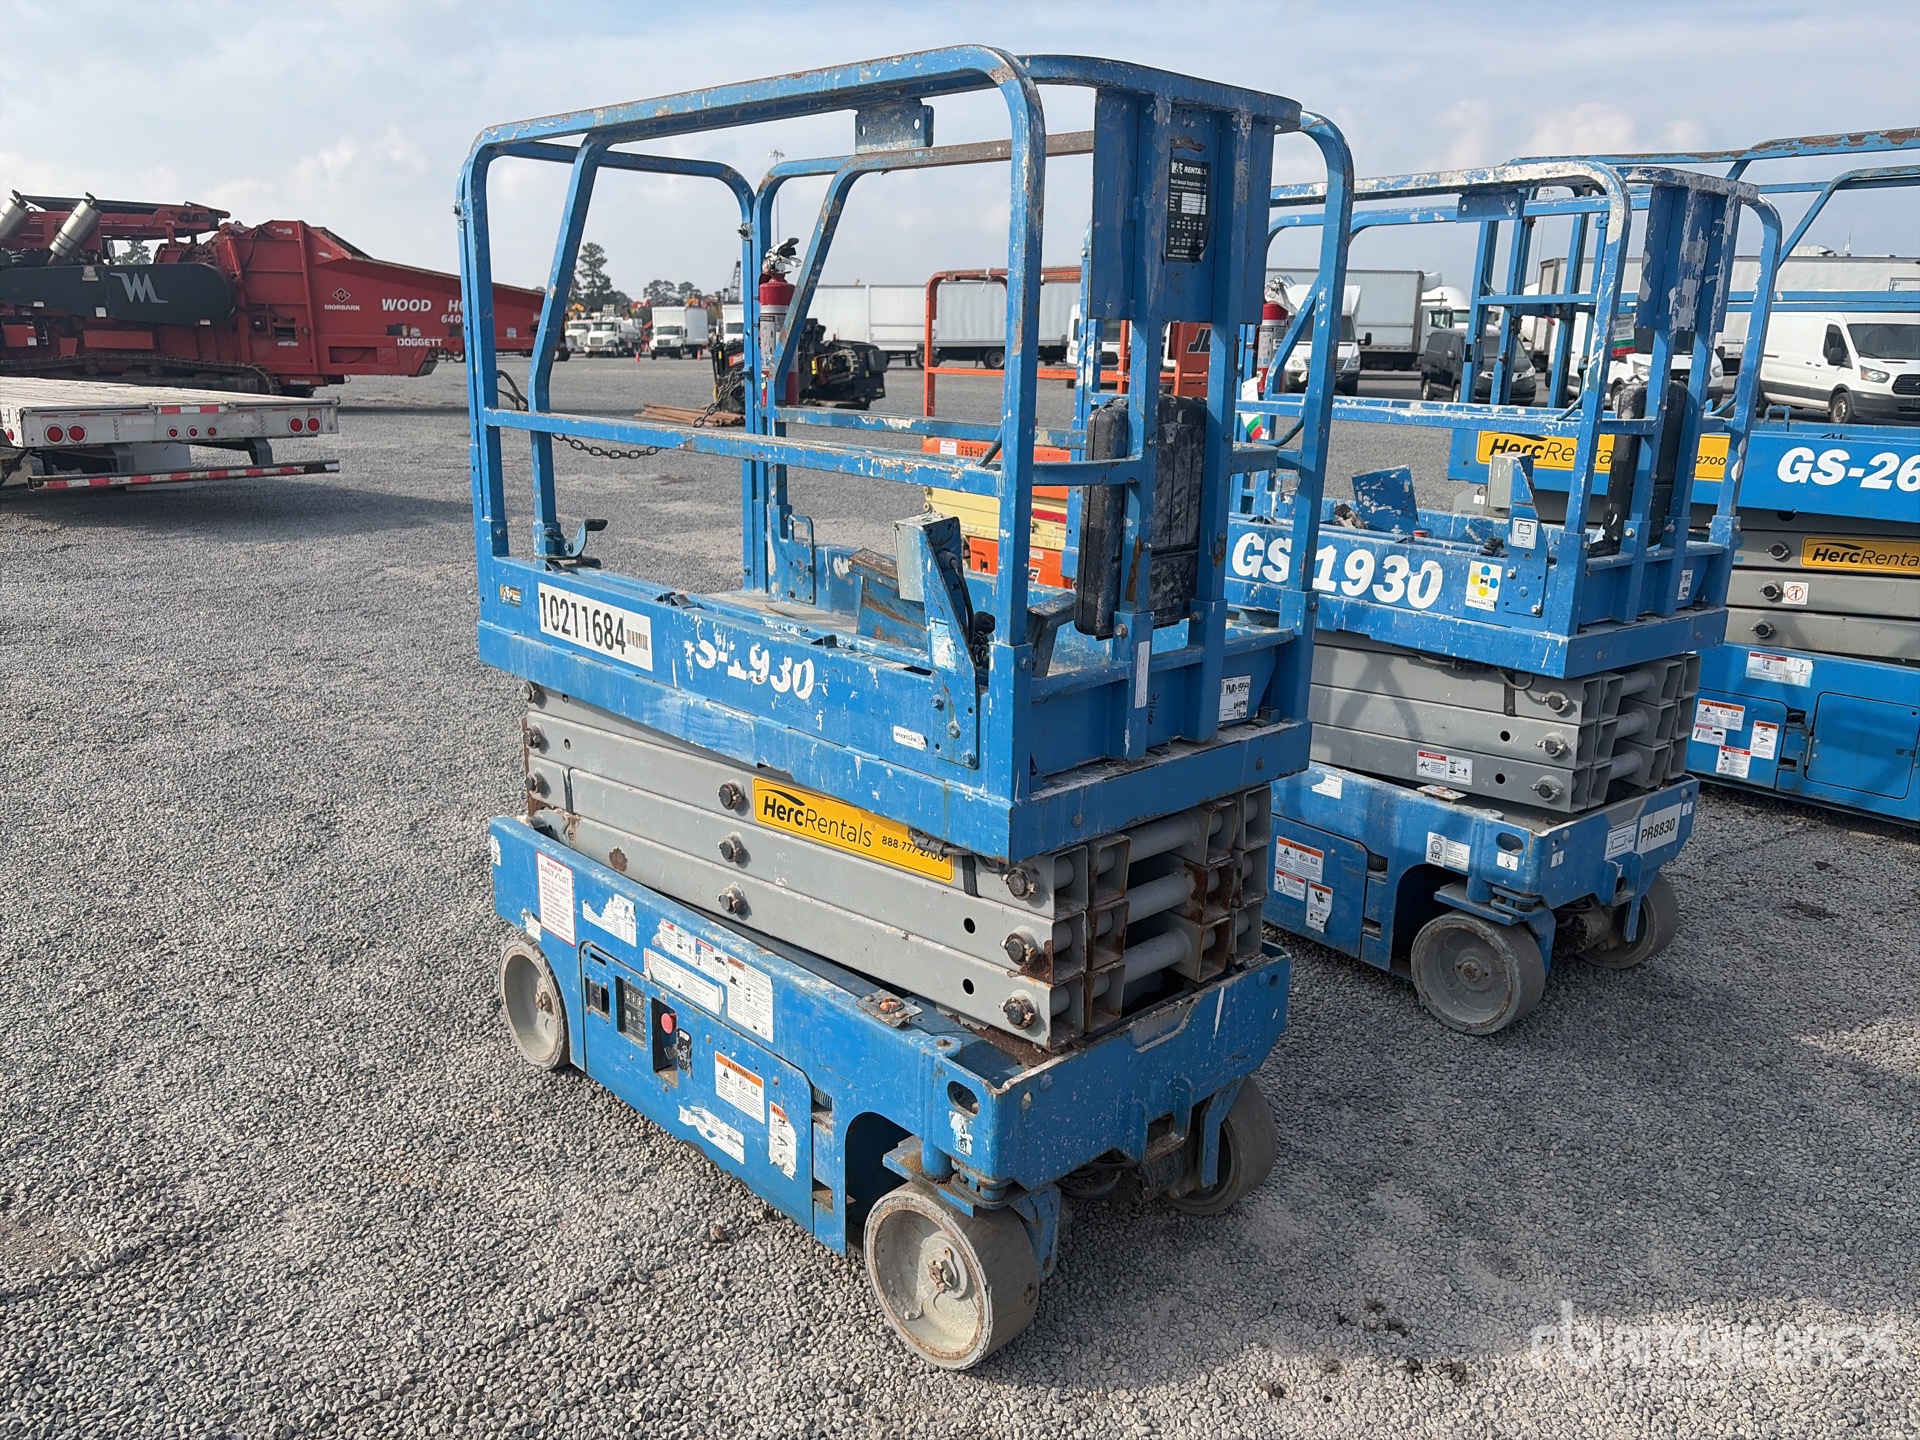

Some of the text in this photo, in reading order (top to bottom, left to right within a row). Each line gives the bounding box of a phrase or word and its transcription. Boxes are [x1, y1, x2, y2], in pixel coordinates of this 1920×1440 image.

[1184, 165, 1207, 176] RENTALS
[382, 298, 432, 312] WOOD
[441, 314, 463, 324] 640
[397, 338, 442, 347] DOGGETT
[1232, 532, 1443, 609] GS1930
[540, 592, 626, 655] 10211684
[1641, 818, 1676, 843] PR8830
[541, 864, 569, 885] DAILY LIST
